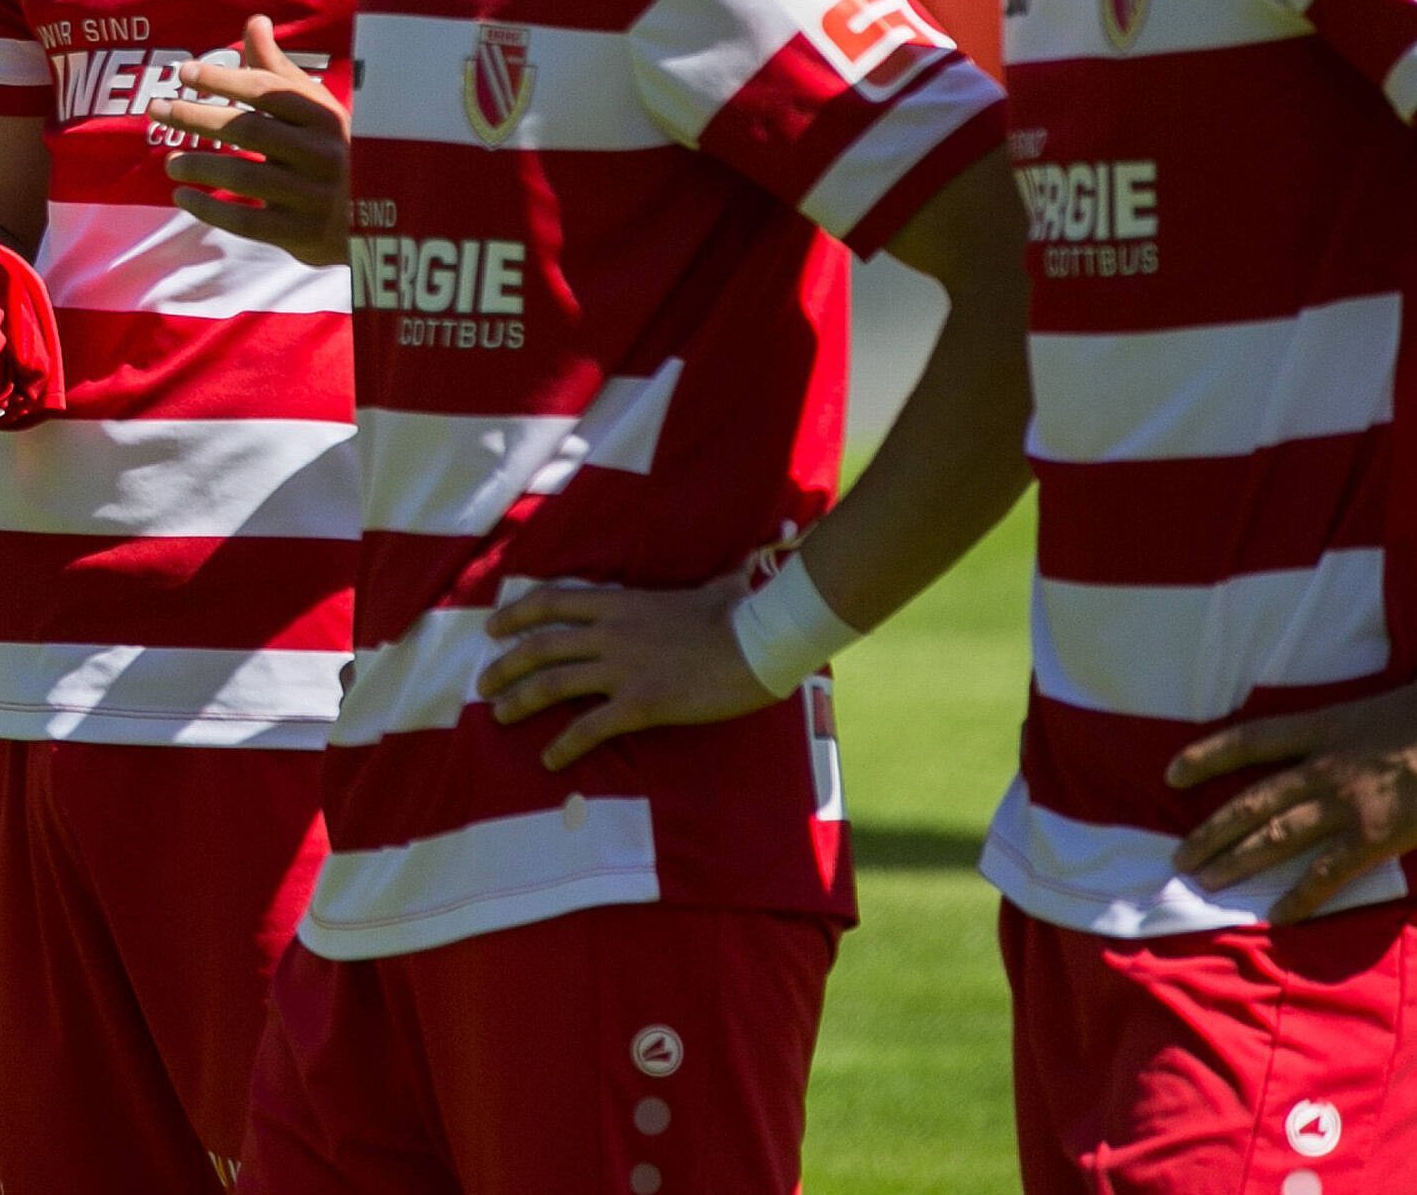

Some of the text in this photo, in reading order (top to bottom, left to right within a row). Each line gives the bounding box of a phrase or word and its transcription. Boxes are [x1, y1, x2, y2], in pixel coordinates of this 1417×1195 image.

[37, 16, 151, 50] WIR SIND
[397, 316, 526, 350] COTTBUS
